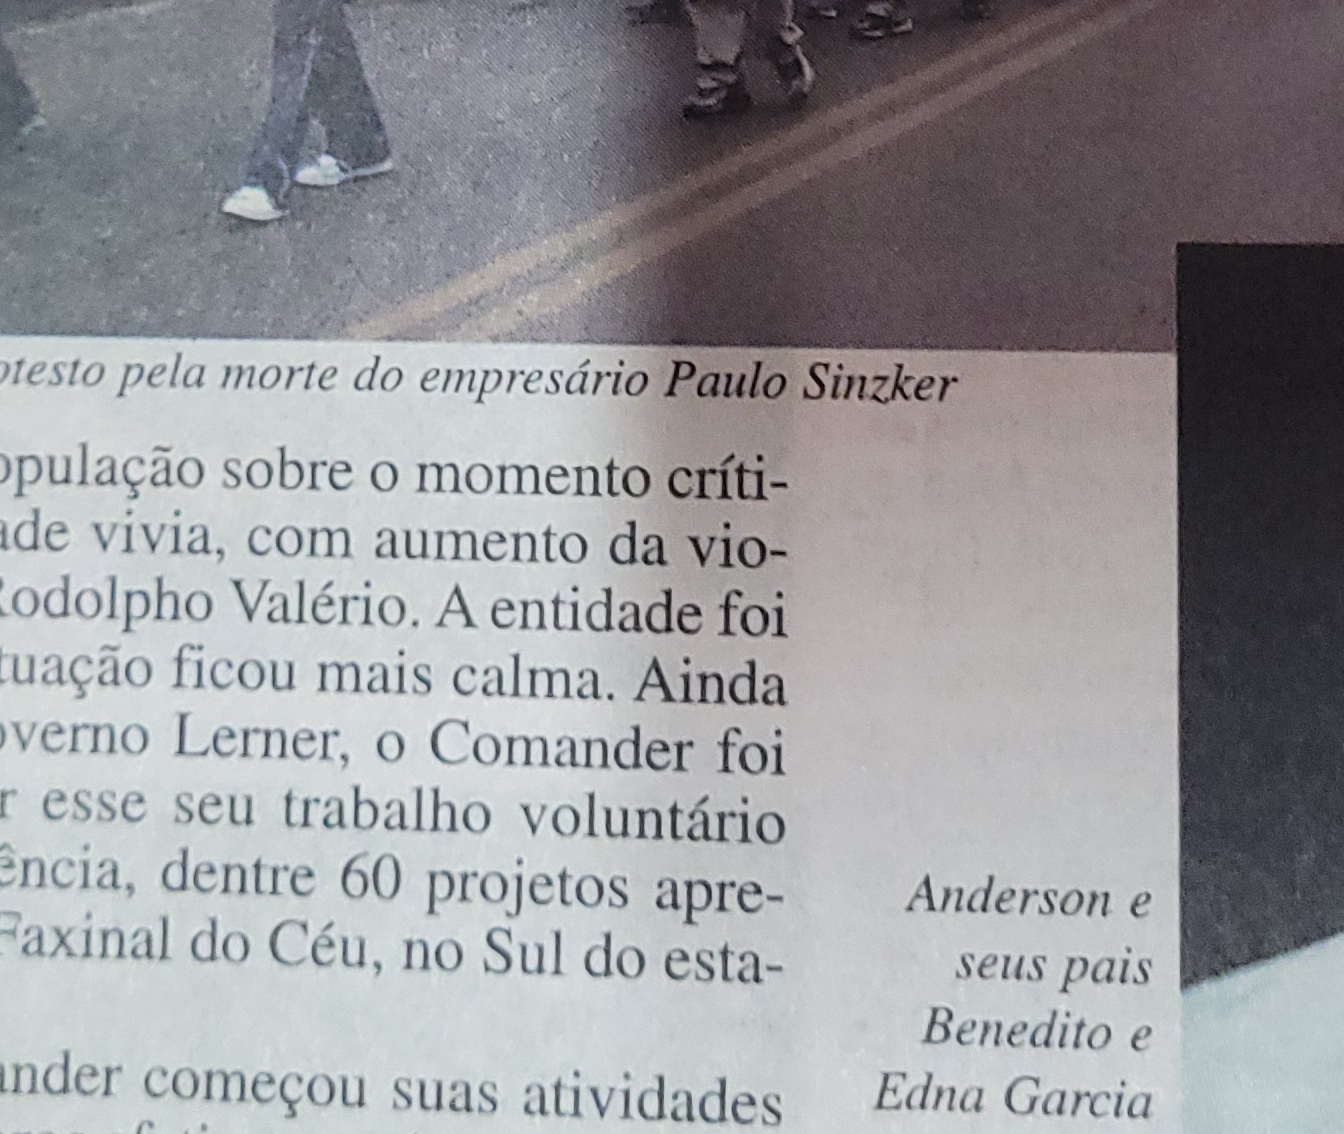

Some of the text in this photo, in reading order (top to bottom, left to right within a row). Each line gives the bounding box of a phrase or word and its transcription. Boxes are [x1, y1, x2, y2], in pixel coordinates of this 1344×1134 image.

[116, 353, 206, 398] pela
[221, 362, 338, 391] morte
[353, 355, 403, 392] do
[420, 359, 648, 404] empresário
[664, 360, 787, 399] Paulo
[803, 363, 959, 405] Sinzker
[222, 445, 353, 491] sobre
[370, 461, 399, 492] o
[416, 458, 651, 498] momento
[668, 453, 788, 501] críti-
[92, 509, 225, 563] vivia,
[248, 526, 353, 559] com
[375, 525, 588, 564] aumento
[609, 520, 668, 566] da
[687, 521, 788, 569] vio-
[230, 578, 419, 628] Valério.
[435, 583, 478, 628] A
[491, 585, 702, 635] entidade
[718, 589, 788, 638] foi
[172, 643, 296, 692] ficou
[317, 649, 432, 695] mais
[453, 653, 614, 701] calma.
[633, 656, 788, 707] Ainda
[175, 712, 349, 767] Lerner,
[376, 731, 405, 763] o
[430, 719, 694, 772] Comander
[717, 727, 786, 776] foi
[43, 789, 146, 823] esse
[174, 793, 254, 827] seu
[284, 785, 491, 834] trabalho
[520, 792, 786, 845] voluntário
[161, 847, 315, 897] dentre
[341, 851, 401, 900] 60
[427, 857, 628, 919] projetos
[655, 878, 784, 926] apre-
[905, 873, 1151, 919] Anderson e
[190, 917, 250, 963] do
[269, 919, 382, 976] Céu,
[403, 939, 463, 972] no
[483, 927, 563, 976] Sul
[584, 931, 646, 979] do
[664, 942, 783, 985] esta-
[955, 947, 1152, 994] seus pais
[921, 1007, 1152, 1052] Benedito e
[144, 1067, 366, 1119] começou
[393, 1078, 498, 1114] suas
[523, 1069, 782, 1127] atividades
[874, 1072, 1152, 1119] Edna Garcia
